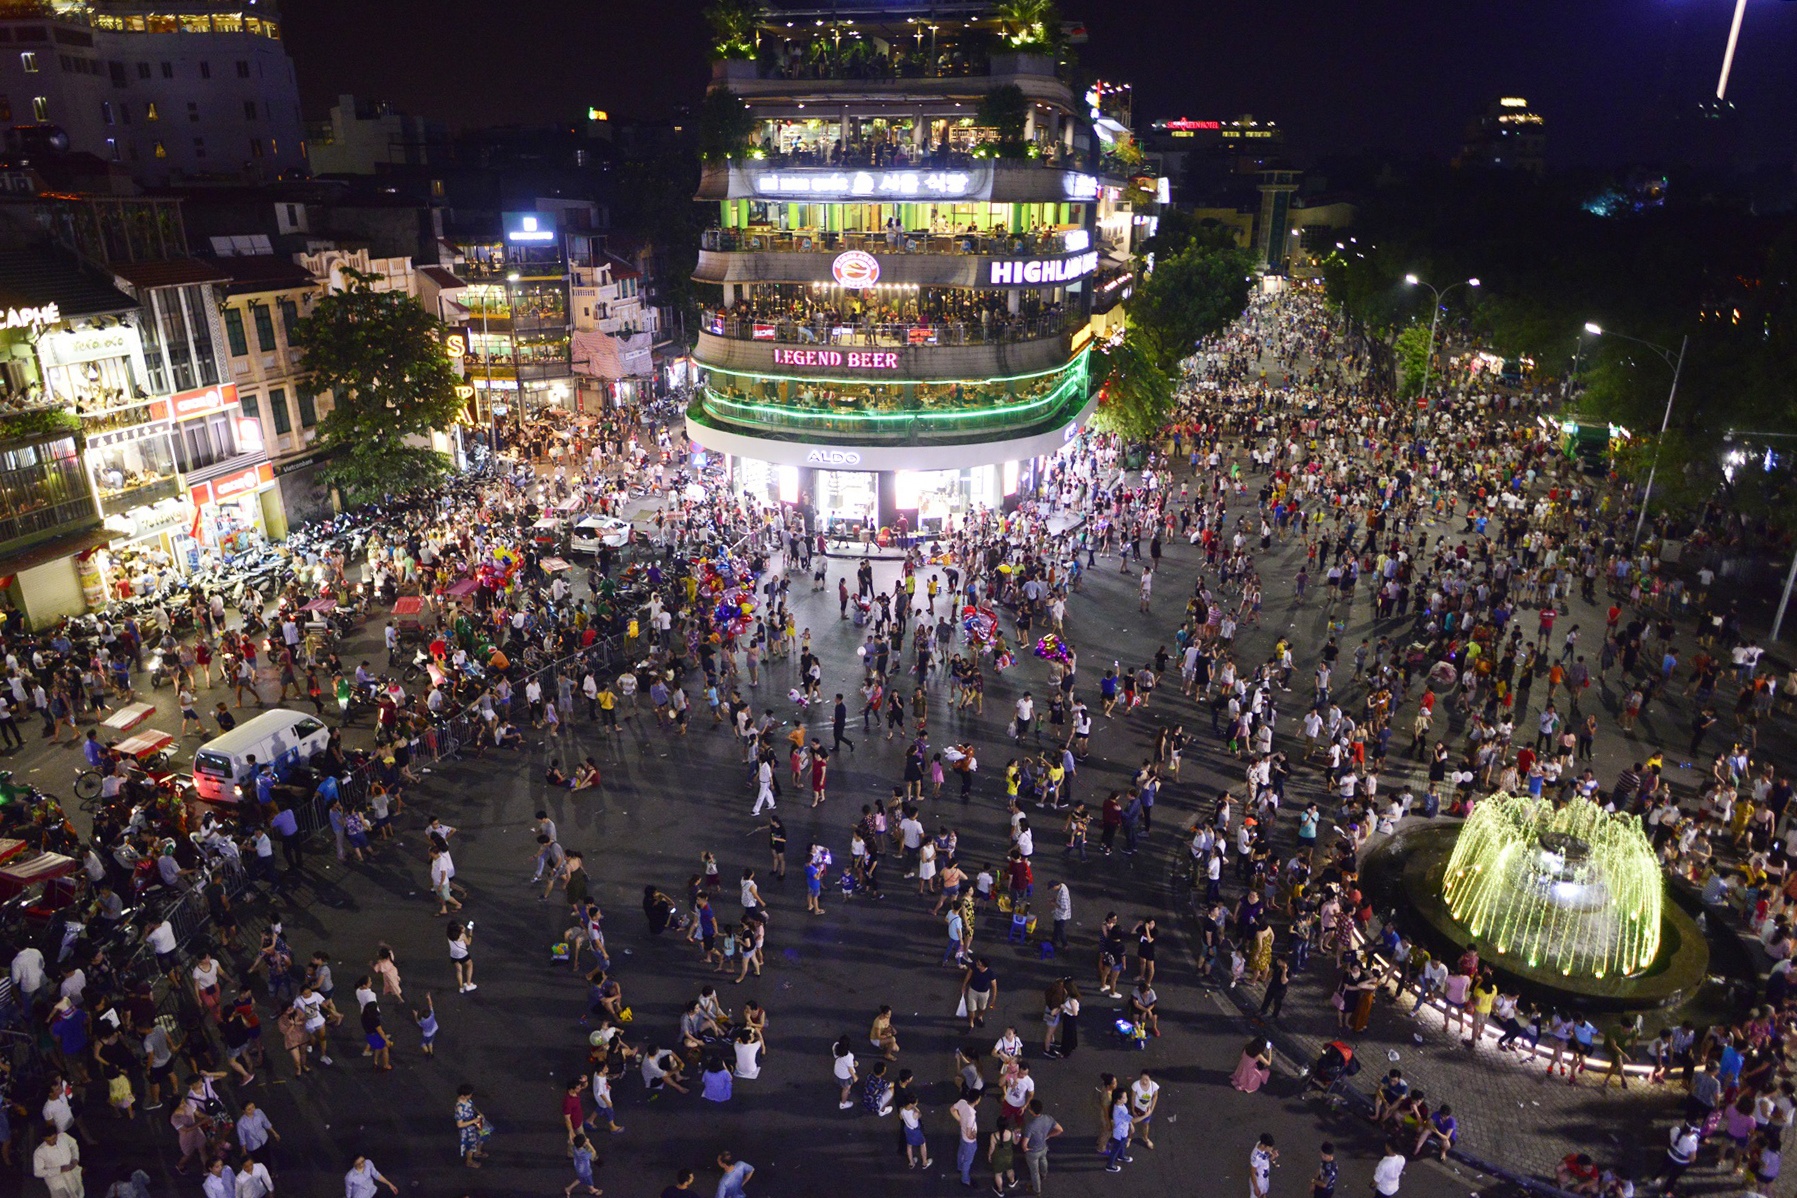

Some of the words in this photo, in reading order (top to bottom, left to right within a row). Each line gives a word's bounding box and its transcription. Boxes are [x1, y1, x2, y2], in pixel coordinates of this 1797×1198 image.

[774, 349, 842, 366] LEGEND
[847, 352, 899, 369] BEER
[807, 450, 861, 465] ALDO
[283, 458, 314, 473] Vietcombank
